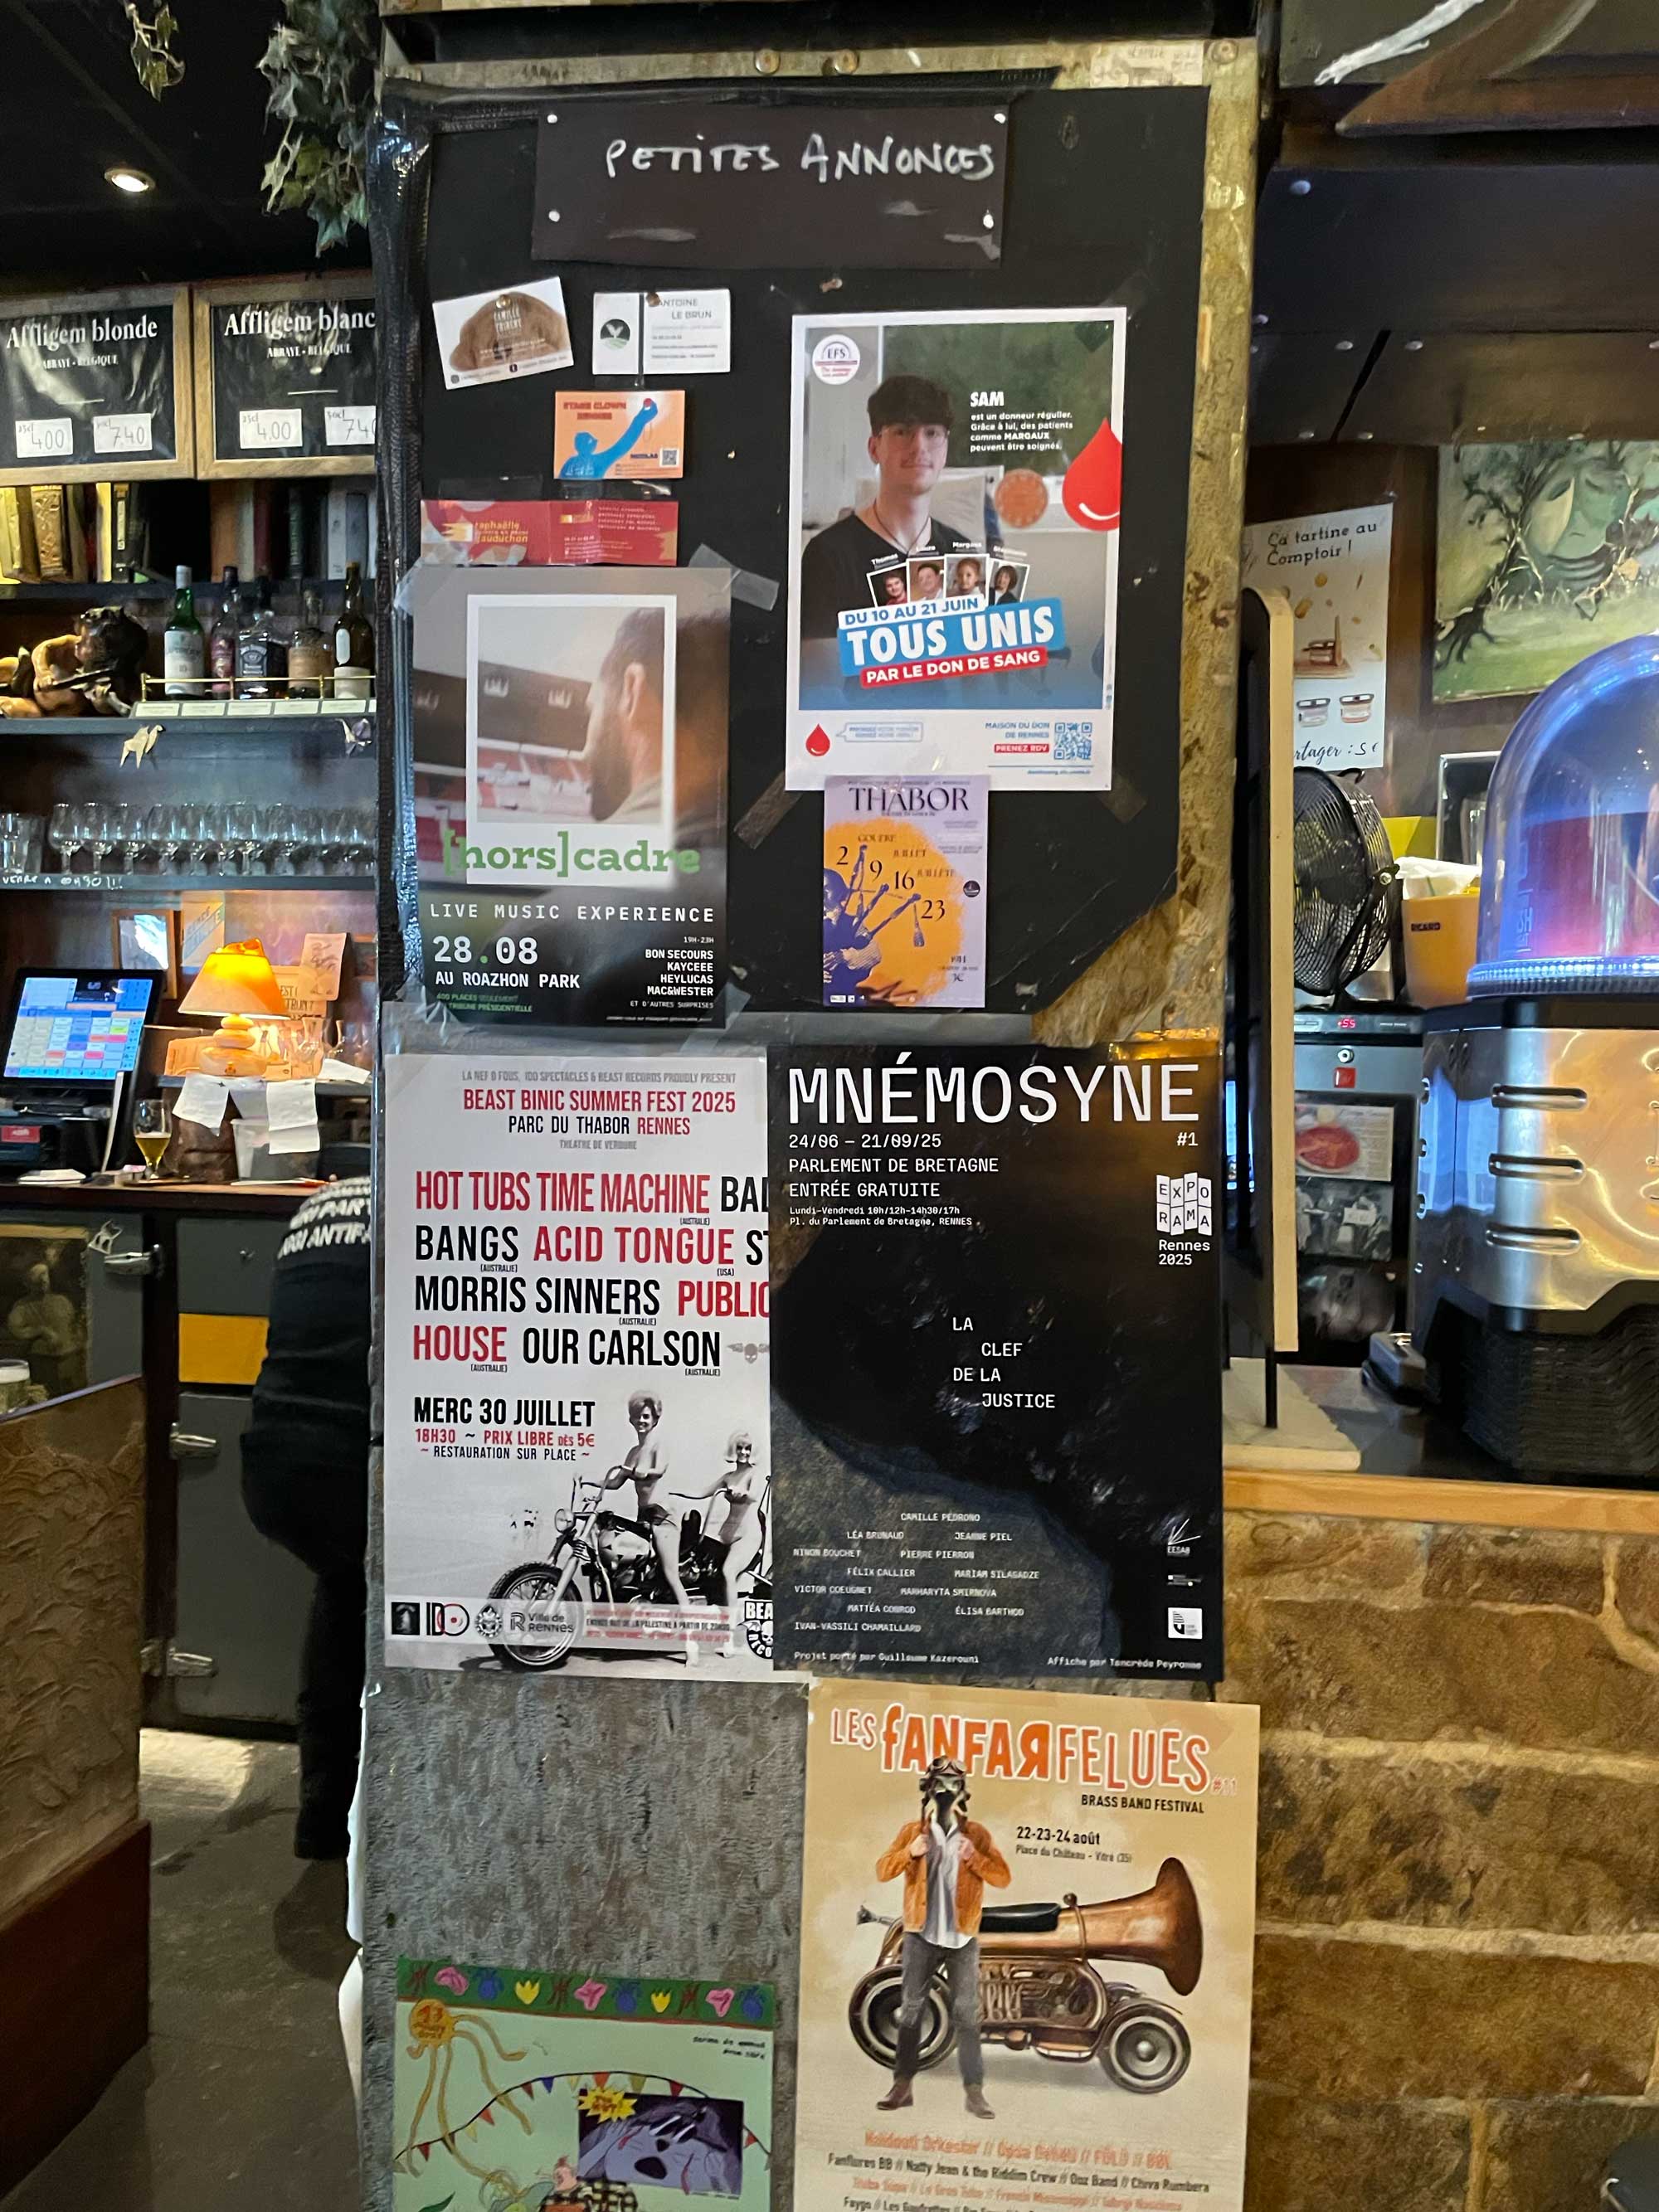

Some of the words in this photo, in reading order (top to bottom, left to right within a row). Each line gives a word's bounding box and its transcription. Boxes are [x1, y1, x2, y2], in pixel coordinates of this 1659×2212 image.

[605, 134, 780, 178] PETITES
[800, 133, 994, 183] ANNONCES
[659, 299, 698, 307] NTOINE
[672, 311, 683, 320] LE
[685, 310, 712, 319] BRUN
[224, 310, 312, 339] Affligem
[6, 322, 85, 352] Affligem
[92, 315, 158, 342] blonde
[970, 391, 1005, 407] SAM
[971, 423, 995, 431] Grâce
[997, 421, 1003, 430] à
[1038, 421, 1073, 430] patients
[1004, 432, 1049, 440] MARGAUX
[970, 444, 1005, 453] peuvent
[1296, 527, 1349, 543] tartine
[1356, 523, 1376, 533] au
[1267, 547, 1340, 566] Comptoir
[845, 614, 867, 625] DU
[873, 610, 888, 621] 10
[895, 606, 917, 619] AU
[922, 604, 937, 615] 21
[942, 599, 979, 612] JUIN
[847, 620, 946, 666] TOUS
[961, 606, 1054, 652] UNIS
[867, 668, 899, 683] PAR
[903, 664, 923, 678] LE
[927, 661, 964, 675] DON
[968, 658, 990, 671] DE
[995, 651, 1040, 668] SANG
[995, 745, 1029, 753] PRENEZ
[849, 787, 969, 811] THABOR
[837, 847, 848, 865] 2
[870, 860, 883, 882] 9
[894, 871, 915, 890] 16
[431, 903, 478, 918] LIVE
[494, 905, 560, 919] MUSIC
[577, 906, 714, 922] EXPERIENCE
[921, 900, 946, 921] 23
[645, 950, 665, 959] BON
[667, 950, 714, 960] SECOURS
[667, 962, 713, 972] KAYCEEE
[435, 971, 453, 985] AU
[463, 972, 528, 987] ROAZHON
[539, 974, 580, 989] PARK
[660, 974, 714, 984] HEYLUCAS
[647, 985, 714, 997] MAC&WESTER
[789, 1051, 1199, 1125] MNÉMOSYNE
[464, 1089, 516, 1110] BEAST
[522, 1089, 565, 1111] BINIC
[569, 1091, 641, 1111] SUMMER
[647, 1091, 687, 1112] FEST
[692, 1091, 736, 1112] 2025
[508, 1116, 543, 1134] PARC
[552, 1116, 569, 1134] DU
[577, 1116, 630, 1135] THABOR
[637, 1117, 690, 1135] RENNES
[789, 1134, 839, 1149] 24/06
[861, 1133, 942, 1149] 21/09/25
[1177, 1132, 1199, 1147] #1
[789, 1158, 881, 1173] PARLEMENT
[888, 1159, 909, 1173] DE
[915, 1158, 999, 1173] BRETAGNE
[416, 1171, 464, 1210] HOT
[469, 1172, 531, 1212] TUBS
[536, 1172, 595, 1213] TIME
[601, 1174, 711, 1213] MACHINE
[789, 1181, 851, 1198] ENTRÉE
[857, 1183, 940, 1198] GRATUITE
[888, 1218, 935, 1227] Bretagne,
[416, 1226, 519, 1262] BANGS
[533, 1226, 604, 1262] ACID
[615, 1227, 734, 1265] TONGUE
[1159, 1239, 1210, 1251] Rennes
[1159, 1253, 1193, 1265] 2025
[416, 1276, 527, 1313] MORRIS
[535, 1276, 660, 1316] SINNERS
[952, 1317, 973, 1331] LA
[413, 1325, 507, 1362] HOUSE
[523, 1327, 579, 1365] OUR
[588, 1328, 720, 1367] CARLSON
[981, 1342, 1023, 1357] CLEF
[953, 1368, 974, 1382] DE
[980, 1368, 1001, 1382] LA
[980, 1393, 1056, 1409] JUSTICE
[414, 1397, 473, 1424] MERC
[479, 1398, 507, 1426] 30
[513, 1400, 596, 1427] JUILLET
[416, 1428, 455, 1443] 18H30
[484, 1430, 513, 1445] PRIX
[518, 1432, 554, 1446] LIBRE
[577, 1433, 596, 1447] 5€
[433, 1446, 510, 1460] RESTAURATION
[517, 1447, 537, 1460] SUR
[544, 1448, 577, 1461] PLACE
[901, 1513, 938, 1522] CAMILLE
[847, 1529, 863, 1539] LÉA
[990, 1533, 1012, 1542] PIEL
[847, 1566, 874, 1576] FÉLIX
[877, 1568, 916, 1577] CALLIER
[831, 1708, 877, 1750] LES
[1082, 1795, 1118, 1807] BRASS
[1121, 1797, 1151, 1809] BAND
[1155, 1799, 1204, 1813] FESTIVAL
[1017, 1826, 1071, 1842] 22-23-24
[1073, 1831, 1100, 1845] août
